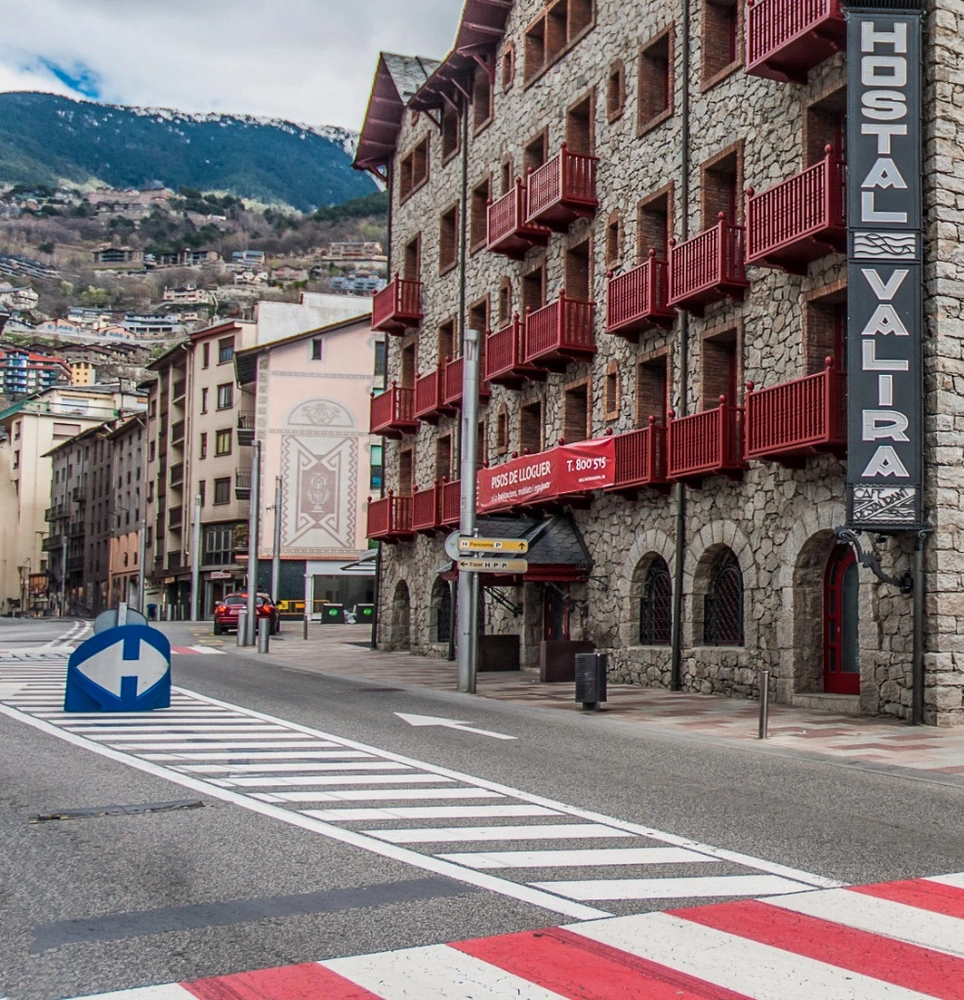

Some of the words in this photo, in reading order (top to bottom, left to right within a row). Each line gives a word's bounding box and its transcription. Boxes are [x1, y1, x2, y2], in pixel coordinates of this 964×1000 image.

[859, 20, 910, 224] HOSTAL
[859, 267, 911, 478] VALIRA
[491, 472, 508, 489] PISOS
[508, 469, 518, 484] DE
[518, 460, 551, 482] LLOGUER
[575, 458, 592, 471] 800
[593, 456, 607, 471] 515
[854, 486, 909, 519] RESTAURANT
